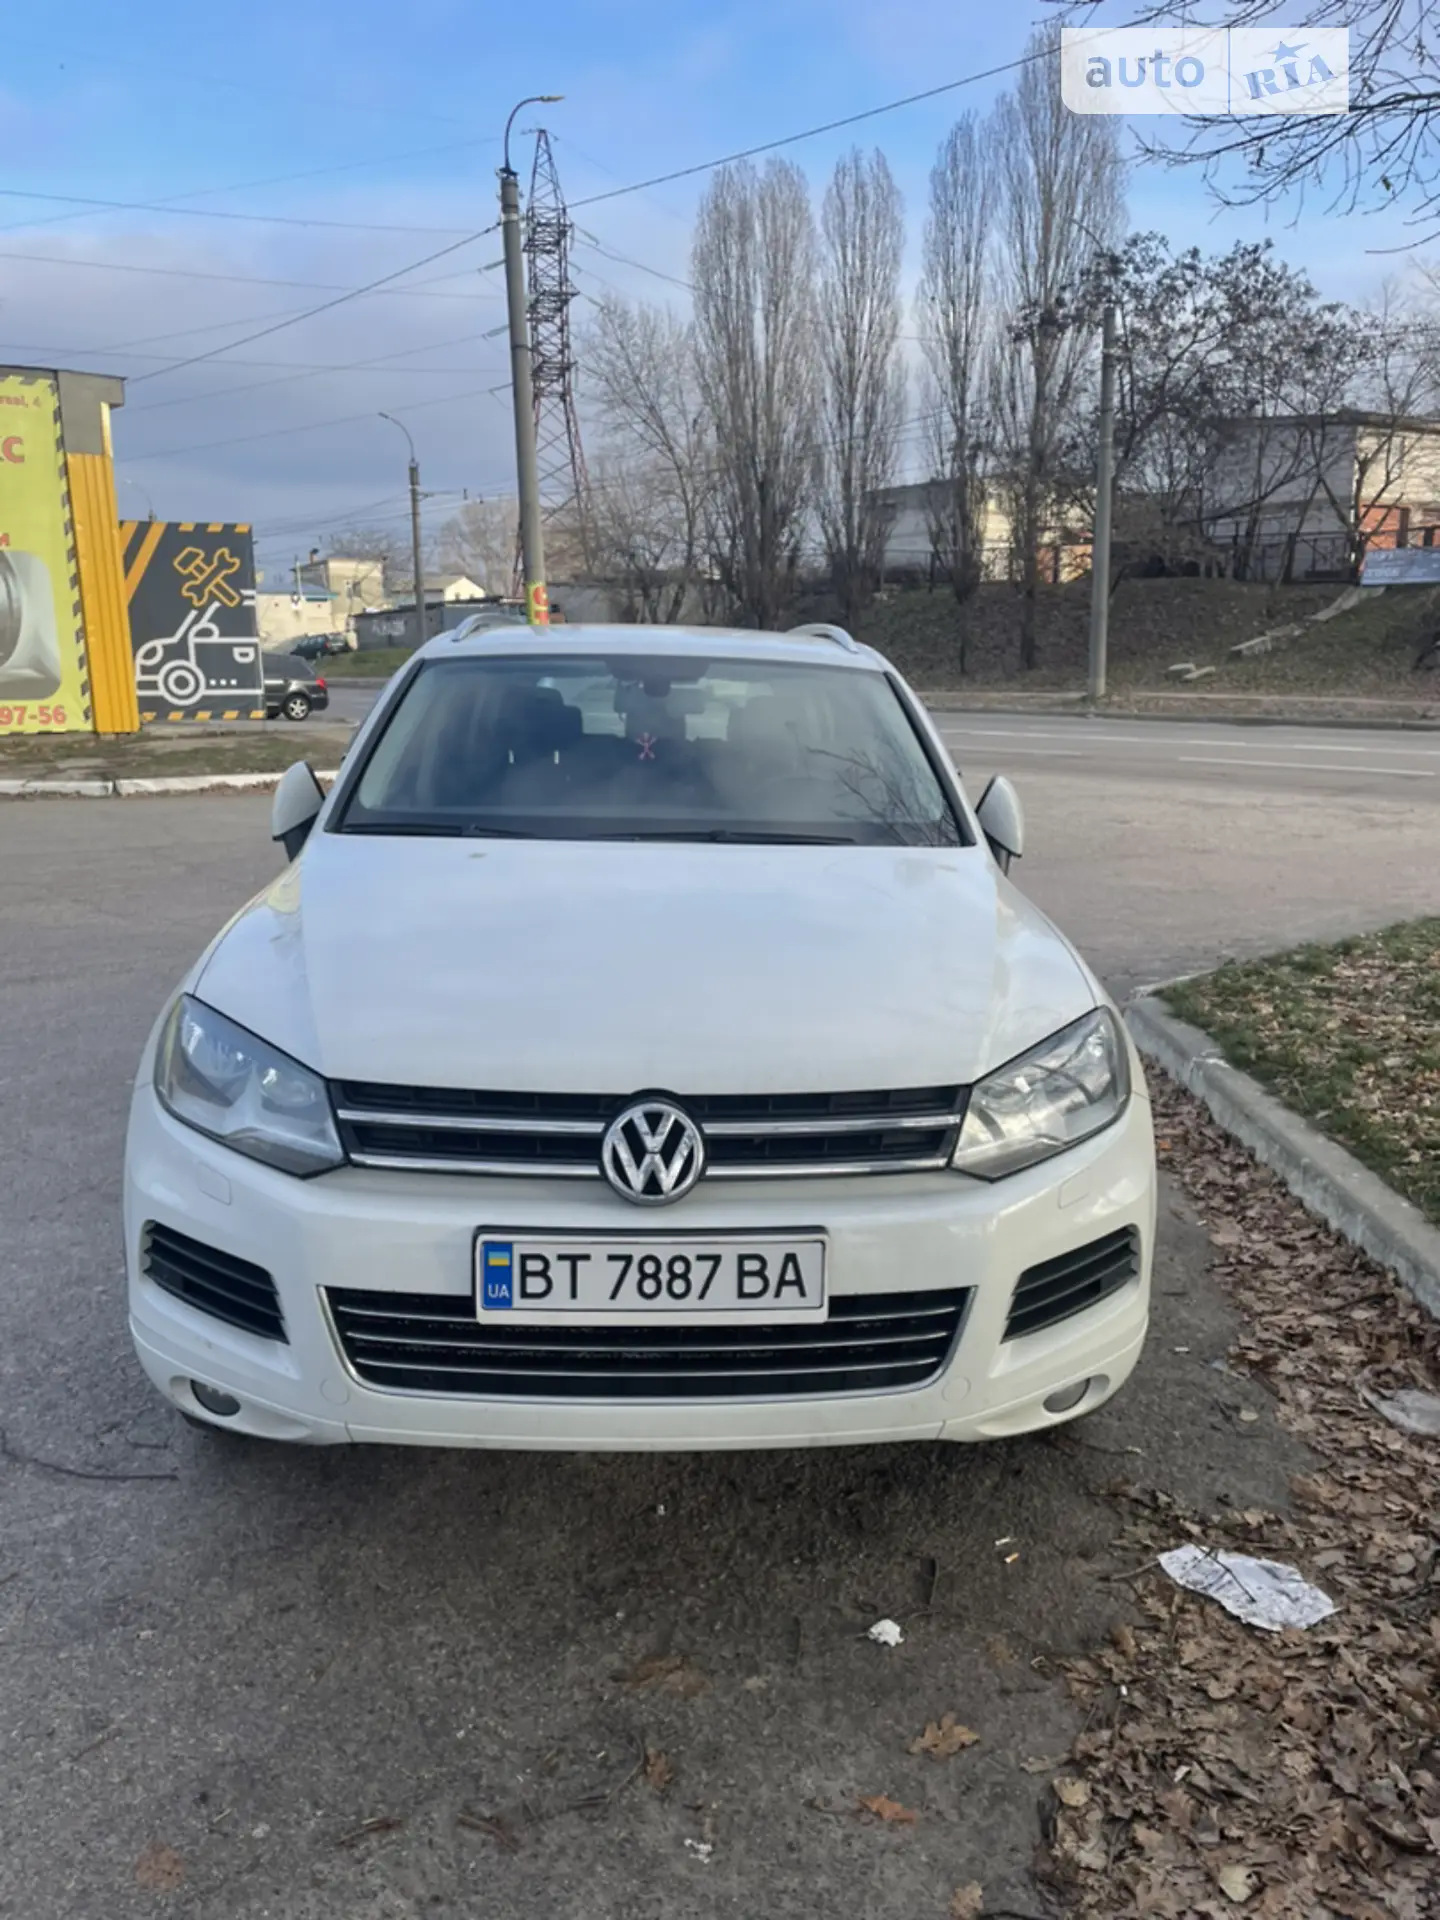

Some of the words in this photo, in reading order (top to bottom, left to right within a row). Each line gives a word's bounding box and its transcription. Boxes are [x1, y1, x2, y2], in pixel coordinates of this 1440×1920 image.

[488, 1283, 510, 1299] UA
[519, 1253, 592, 1300] BT
[606, 1254, 722, 1301] 7887
[737, 1252, 807, 1300] BA
